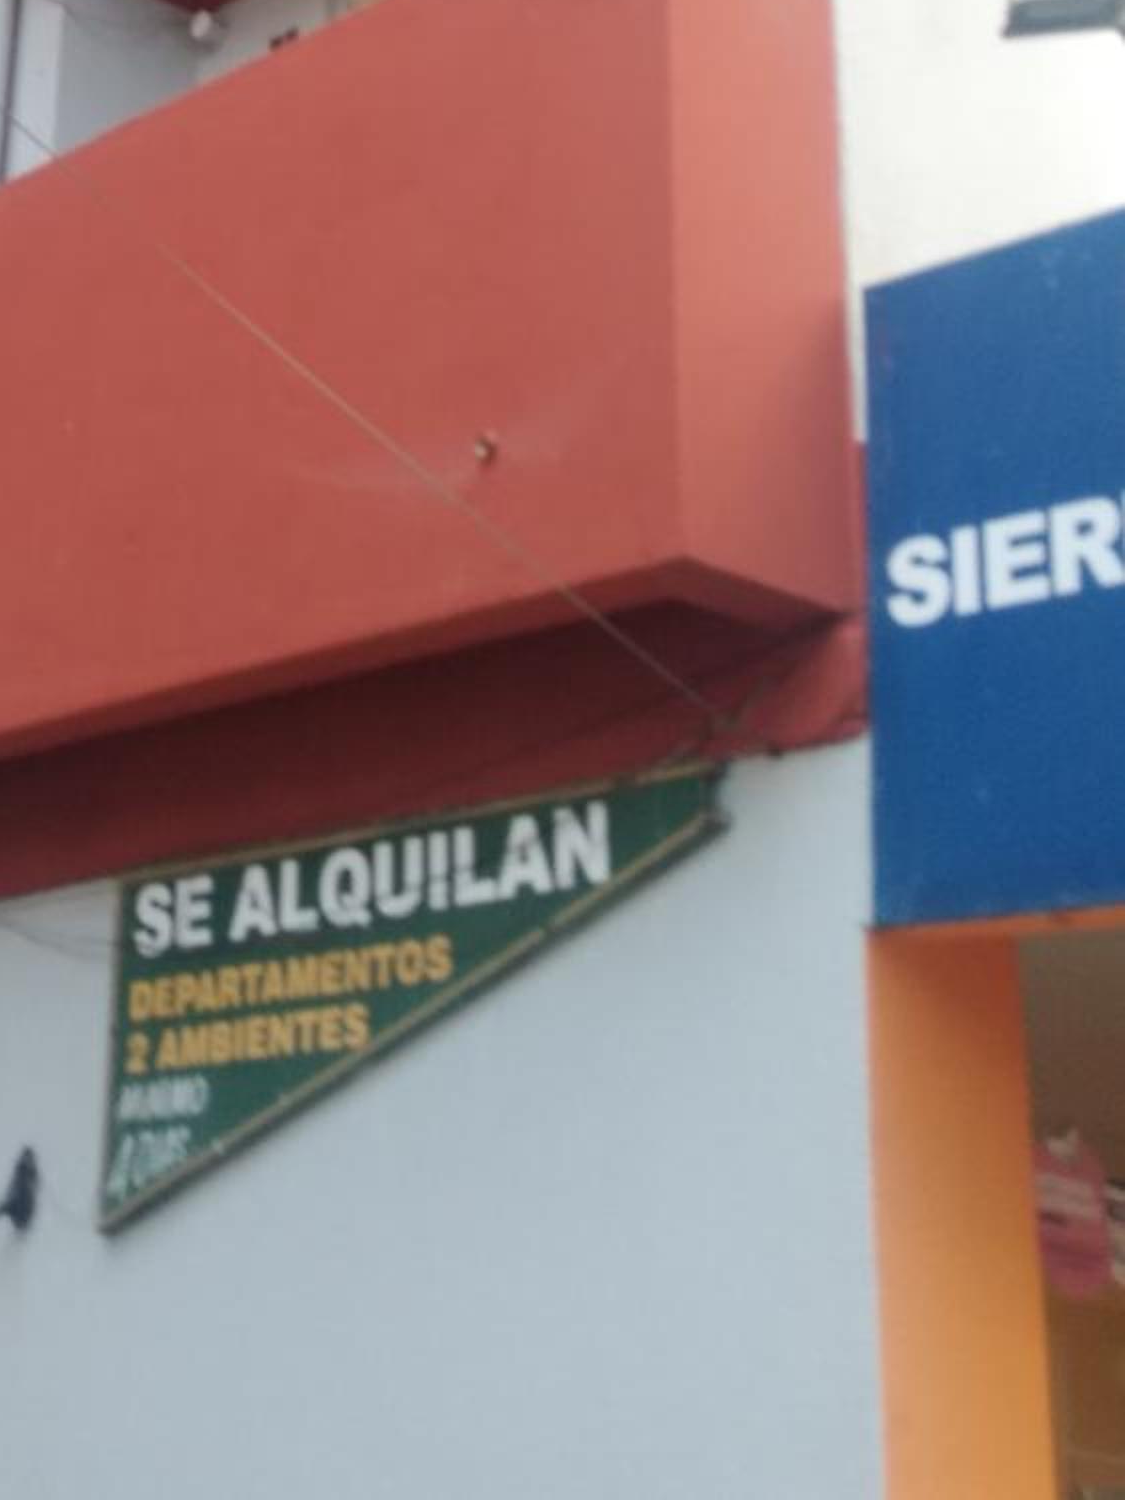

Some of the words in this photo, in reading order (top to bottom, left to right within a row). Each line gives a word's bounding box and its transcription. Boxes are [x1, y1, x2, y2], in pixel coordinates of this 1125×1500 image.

[886, 488, 1125, 628] SIER
[133, 875, 214, 958] SE
[228, 800, 611, 942] ALQUILAN
[128, 934, 454, 1022] DEPARTAMENTOS
[125, 1031, 150, 1075] 2
[155, 1002, 370, 1072] AMBIENTES
